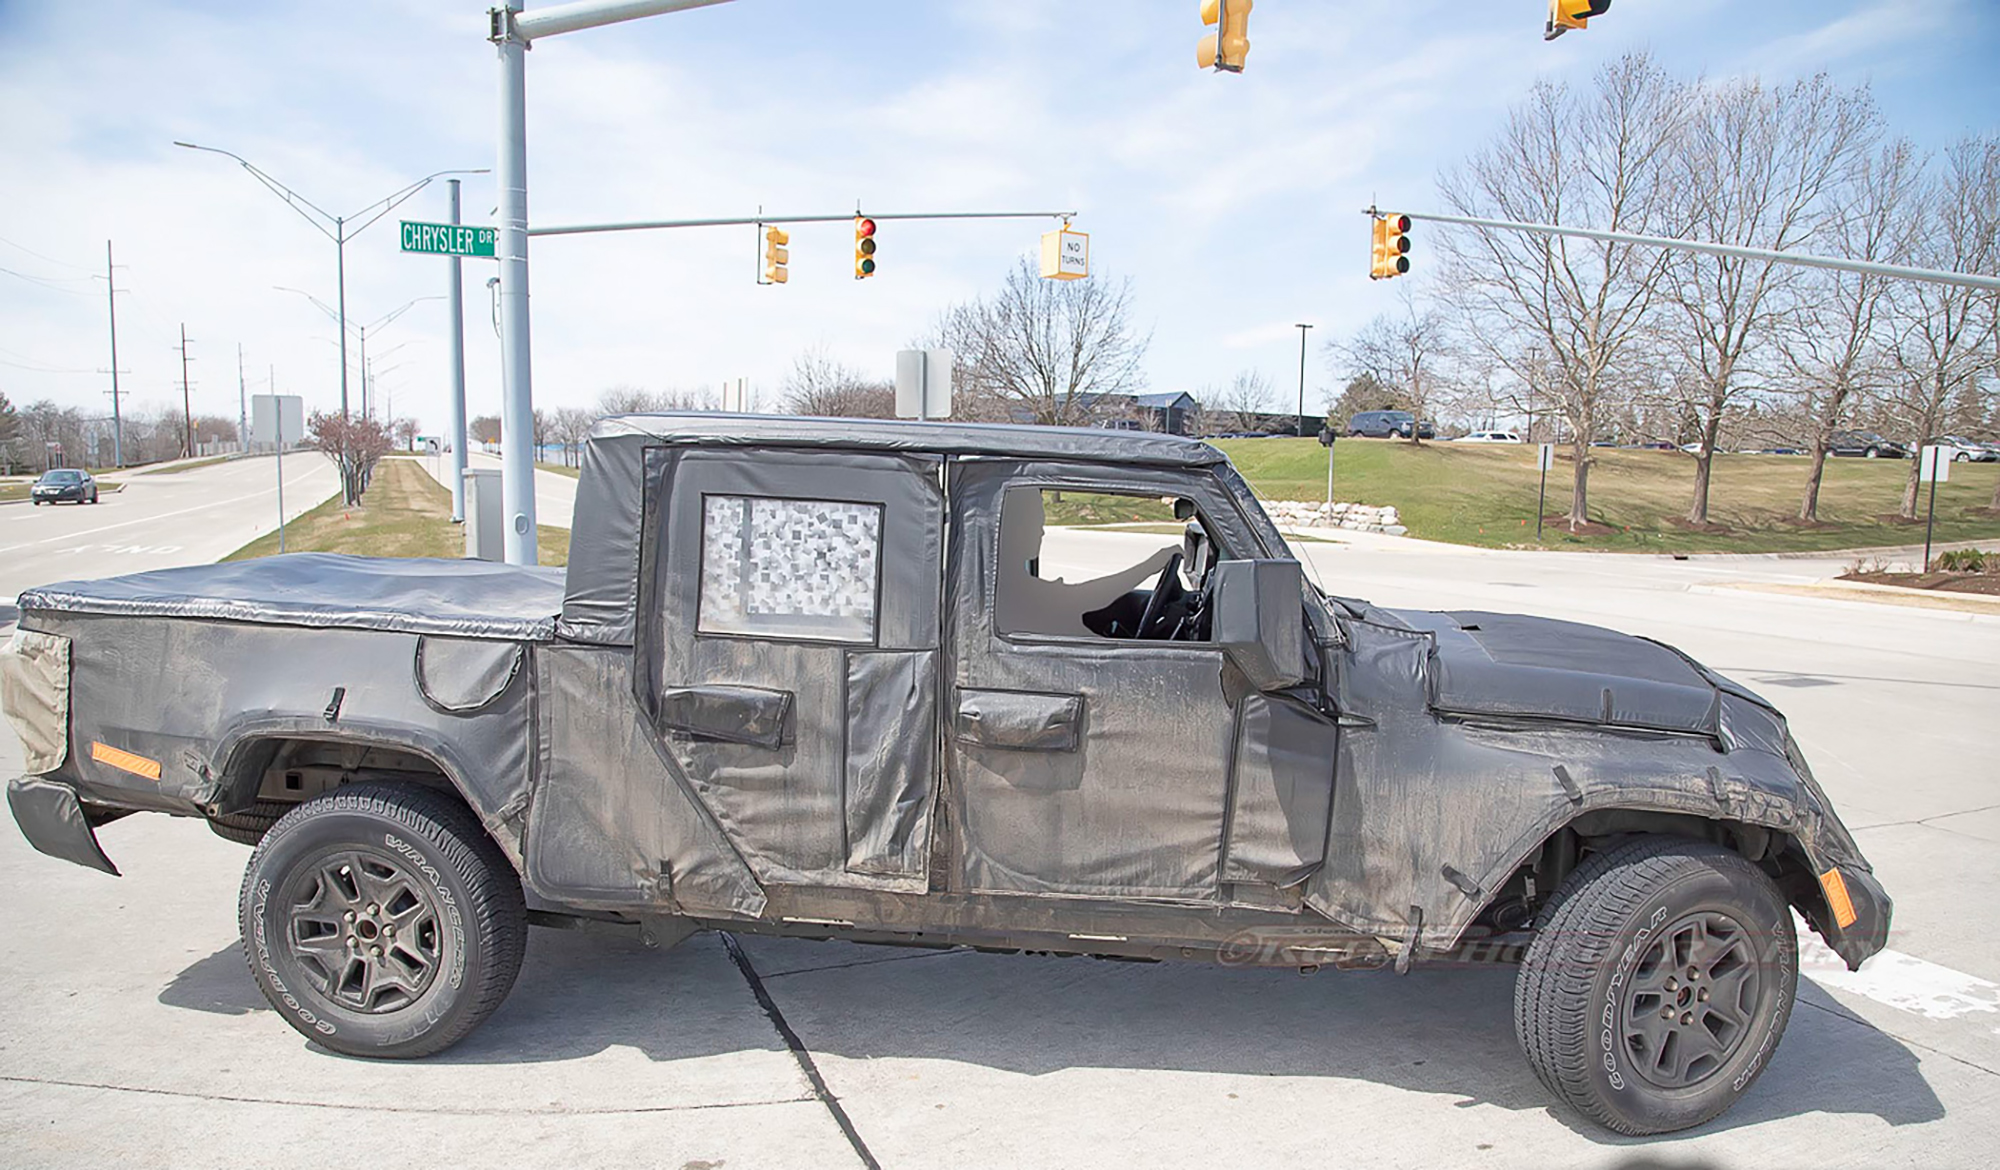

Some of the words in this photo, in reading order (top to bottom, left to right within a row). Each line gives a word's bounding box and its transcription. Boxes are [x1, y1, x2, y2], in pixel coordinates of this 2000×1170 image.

[403, 223, 474, 253] CHRYSLER
[479, 230, 493, 243] DR
[1062, 254, 1085, 266] TURNS
[1067, 242, 1081, 252] NO
[253, 878, 337, 1035] GOODYEAR
[386, 833, 466, 990] WRANGLER
[1601, 906, 1667, 1091] GOODYEAR
[1733, 920, 1789, 1091] WRANGLER
